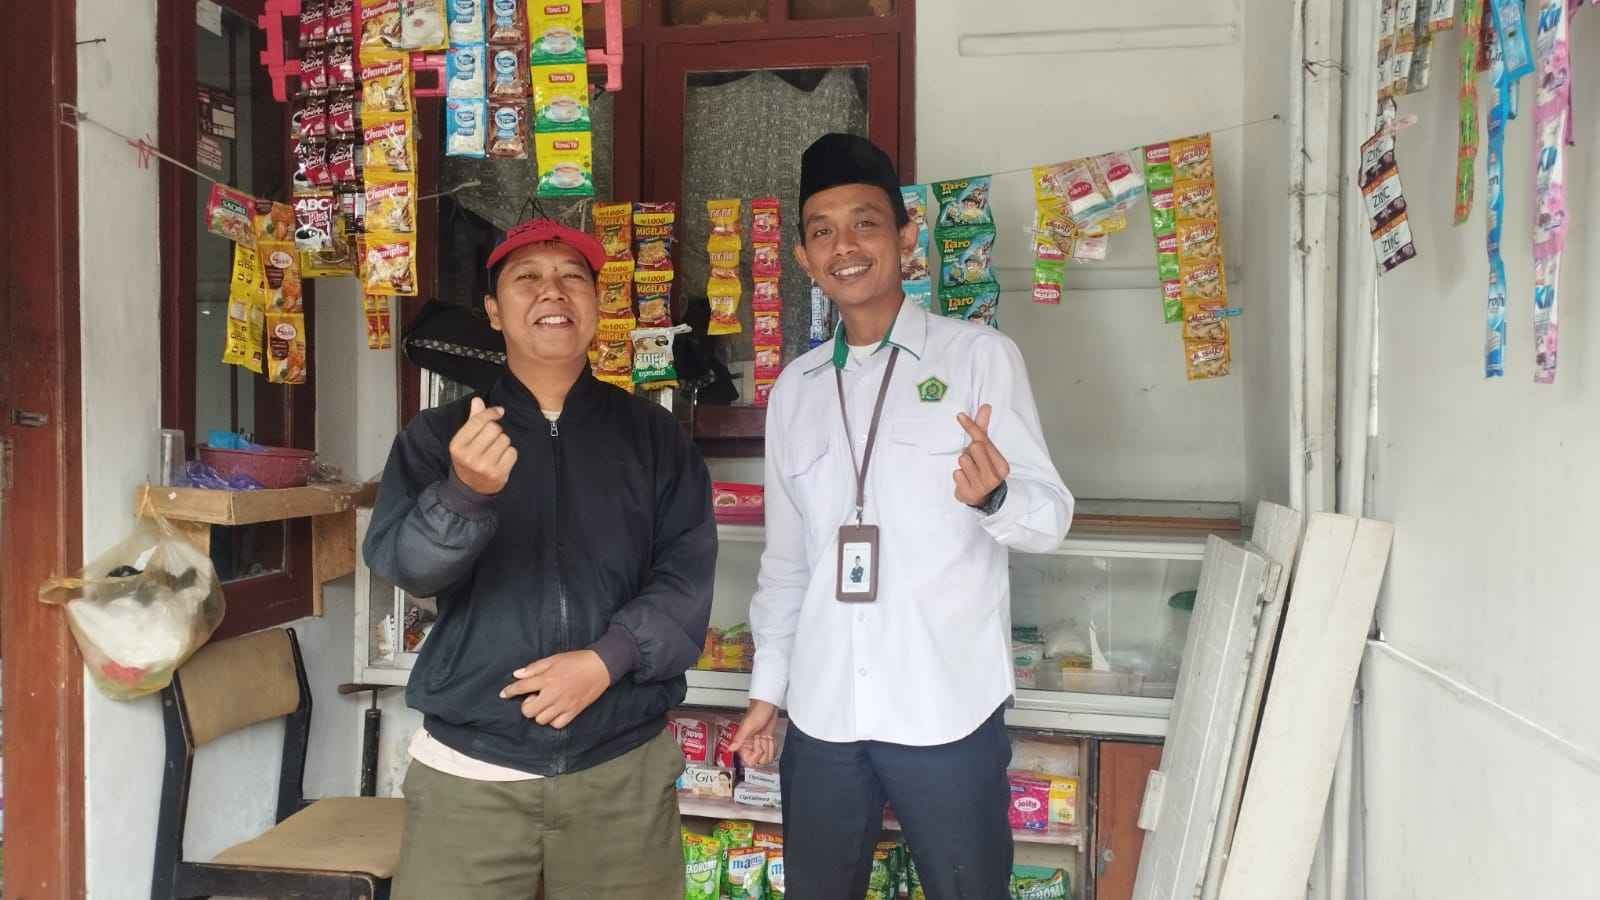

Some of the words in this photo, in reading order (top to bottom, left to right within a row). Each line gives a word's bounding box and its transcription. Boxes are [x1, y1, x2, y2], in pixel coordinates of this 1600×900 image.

[361, 62, 402, 79] Champion
[940, 181, 968, 192] Taro
[1372, 186, 1390, 208] ZINC
[296, 199, 330, 211] ABC
[943, 239, 970, 250] Taro
[1382, 232, 1399, 253] ZINC
[948, 296, 973, 307] Taro
